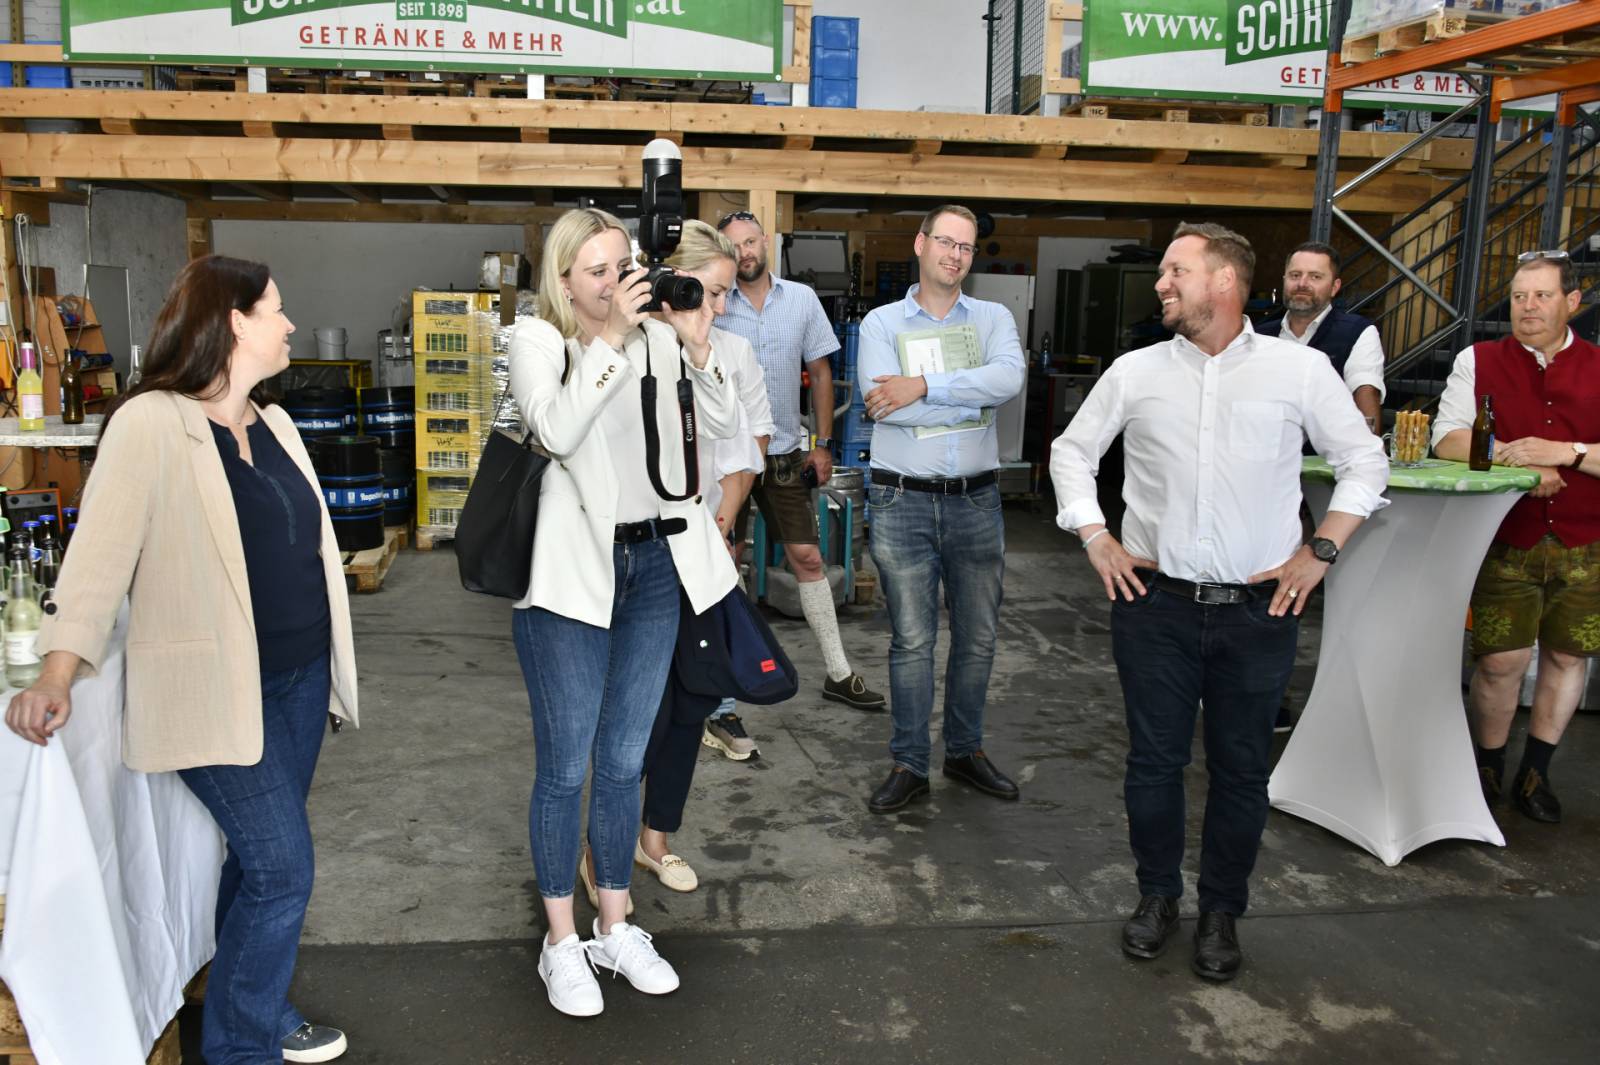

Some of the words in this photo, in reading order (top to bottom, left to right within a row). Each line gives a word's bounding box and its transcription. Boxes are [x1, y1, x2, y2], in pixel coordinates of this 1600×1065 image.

[399, 3, 426, 17] SEIT
[430, 3, 463, 19] 1898
[299, 23, 445, 48] GETRÄNKE
[462, 31, 476, 49] &
[488, 31, 563, 51] MEHR
[1120, 12, 1223, 42] www.
[1236, 0, 1331, 55] SCHR
[1413, 74, 1425, 91] &
